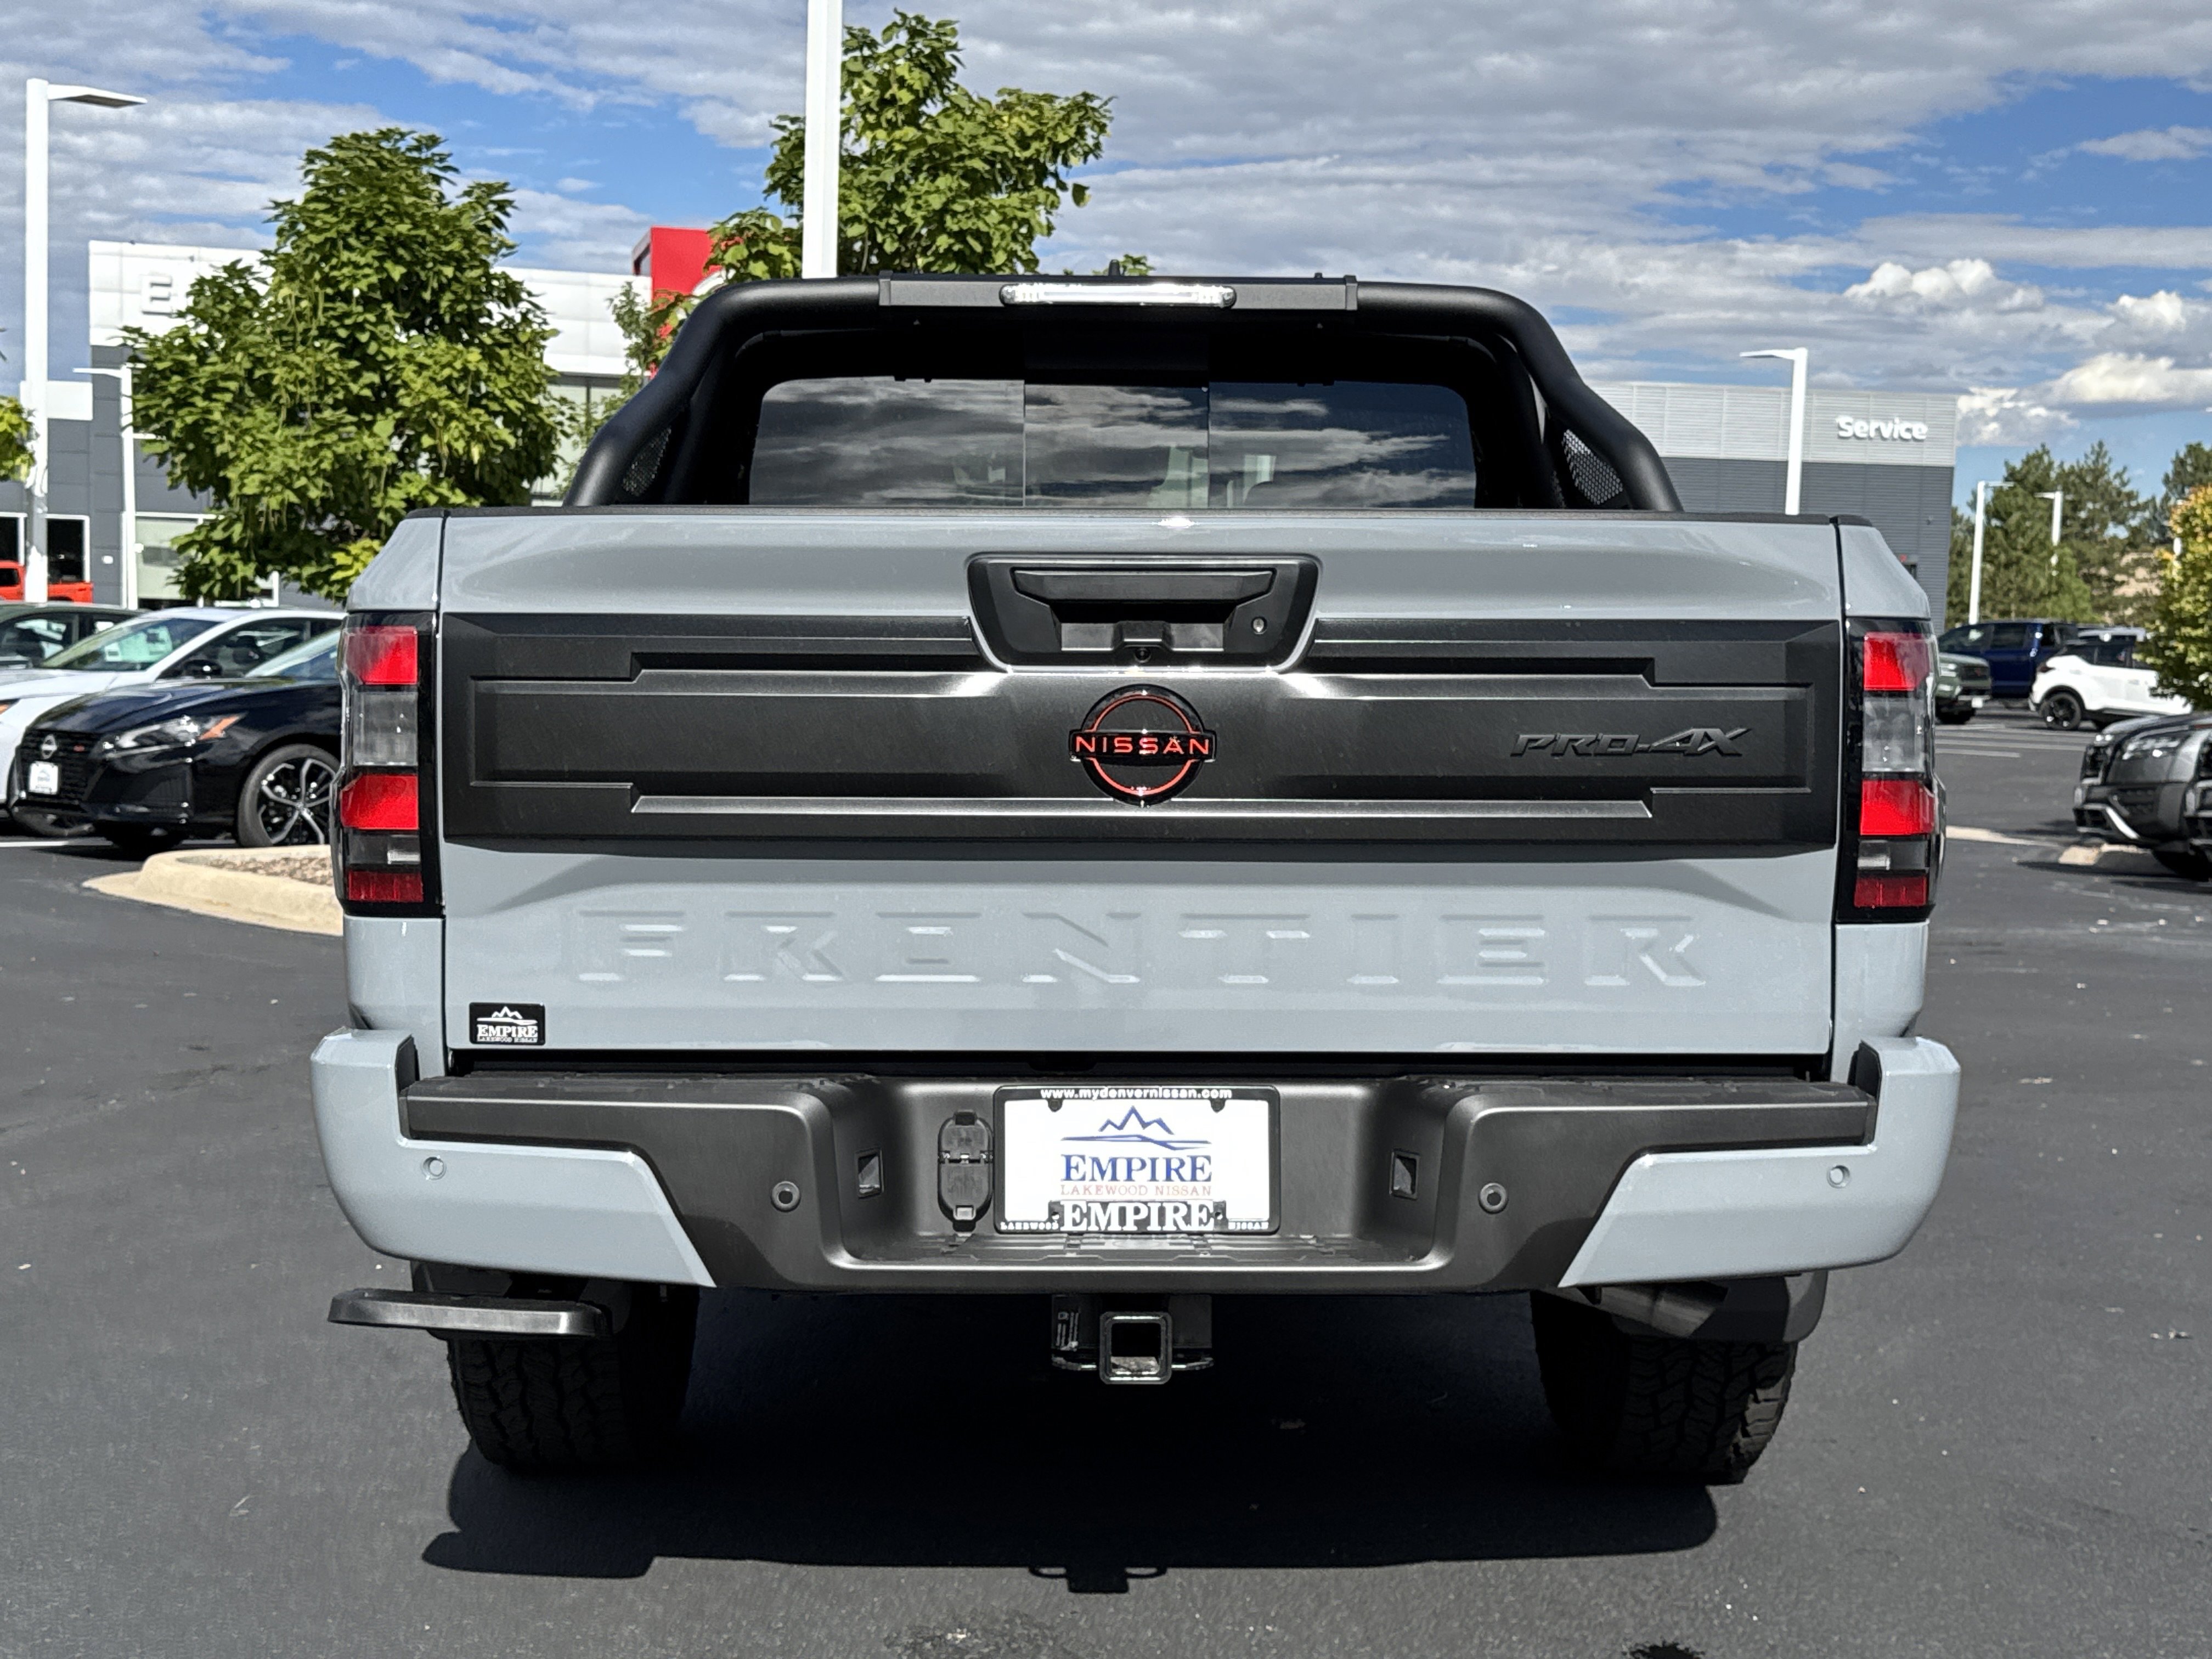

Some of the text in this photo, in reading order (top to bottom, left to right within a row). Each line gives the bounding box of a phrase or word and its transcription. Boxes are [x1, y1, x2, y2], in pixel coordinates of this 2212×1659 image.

[1837, 415, 1928, 441] Service
[1075, 736, 1209, 755] NISSAN
[1510, 727, 1753, 757] PRO-4X
[577, 910, 1708, 987] FRONTIER
[477, 1024, 538, 1038] EMPIRE
[1041, 1086, 1233, 1101] www.mydenvernissan.com
[1060, 1154, 1212, 1182] EMPIRE
[1060, 1184, 1212, 1197] LAKEWOOD NISSAN
[1059, 1201, 1215, 1232] EMPIRE
